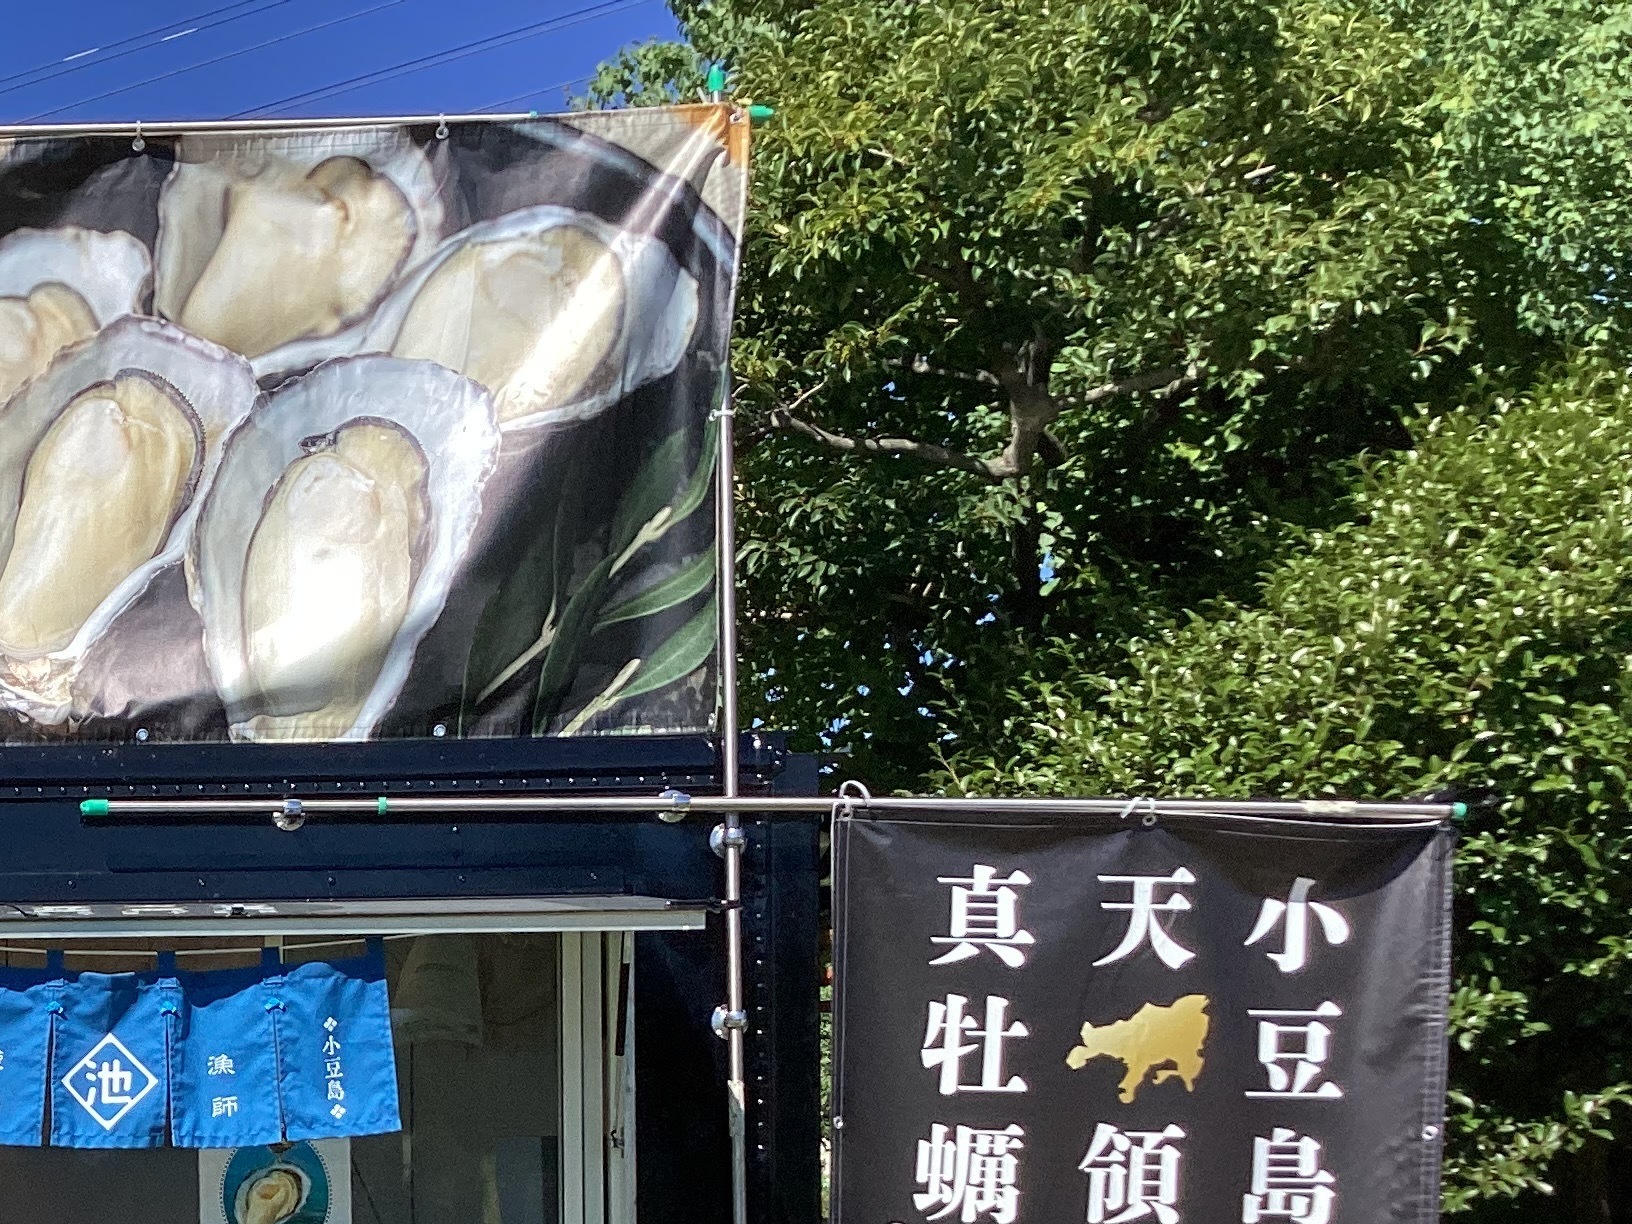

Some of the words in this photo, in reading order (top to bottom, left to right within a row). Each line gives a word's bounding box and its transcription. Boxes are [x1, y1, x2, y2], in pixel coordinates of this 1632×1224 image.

[85, 1062, 135, 1106] 池
[322, 1034, 345, 1101] 小豆島
